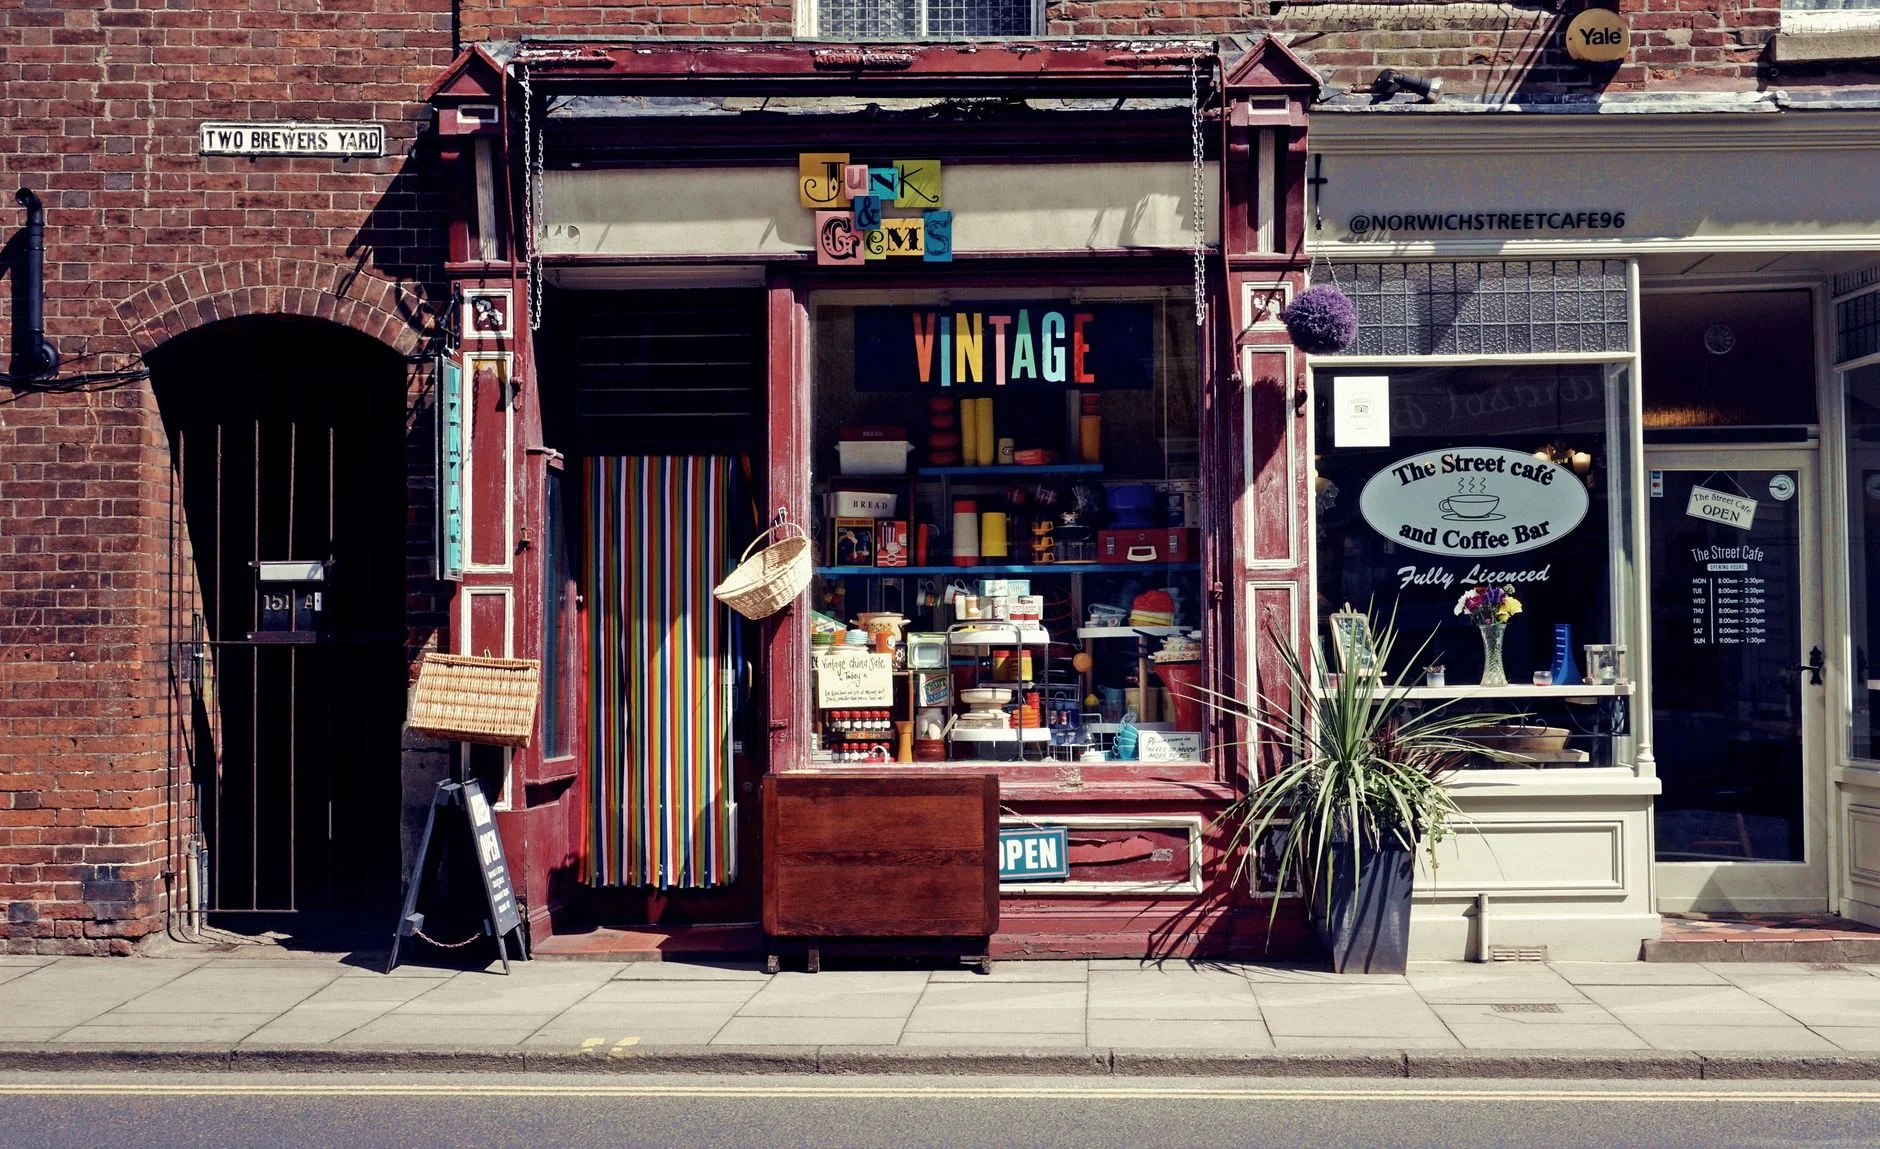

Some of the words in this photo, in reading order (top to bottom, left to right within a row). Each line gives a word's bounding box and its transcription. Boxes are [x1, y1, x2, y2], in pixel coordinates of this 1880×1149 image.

[1579, 27, 1622, 45] Yale
[206, 130, 243, 149] TWO
[251, 131, 328, 150] BREWERS
[338, 132, 378, 150] YARD
[857, 197, 880, 227] &
[1350, 211, 1626, 234] @NORWICHSTREETCAFE96
[913, 309, 1095, 387] VINTAGE
[1392, 460, 1436, 486] The
[1441, 453, 1505, 474] Street
[1510, 460, 1556, 486] café
[853, 500, 888, 510] BREAD
[1694, 493, 1709, 502] The
[1711, 493, 1734, 505] Street
[1702, 504, 1740, 522] OPEN
[1399, 522, 1437, 546] and
[1443, 529, 1509, 550] Coffee
[1512, 520, 1550, 544] Bar
[1691, 548, 1709, 562] The
[1711, 545, 1740, 559] Street
[1742, 545, 1764, 561] Cafe
[1397, 565, 1454, 589] Fully
[1460, 563, 1551, 585] Licenced
